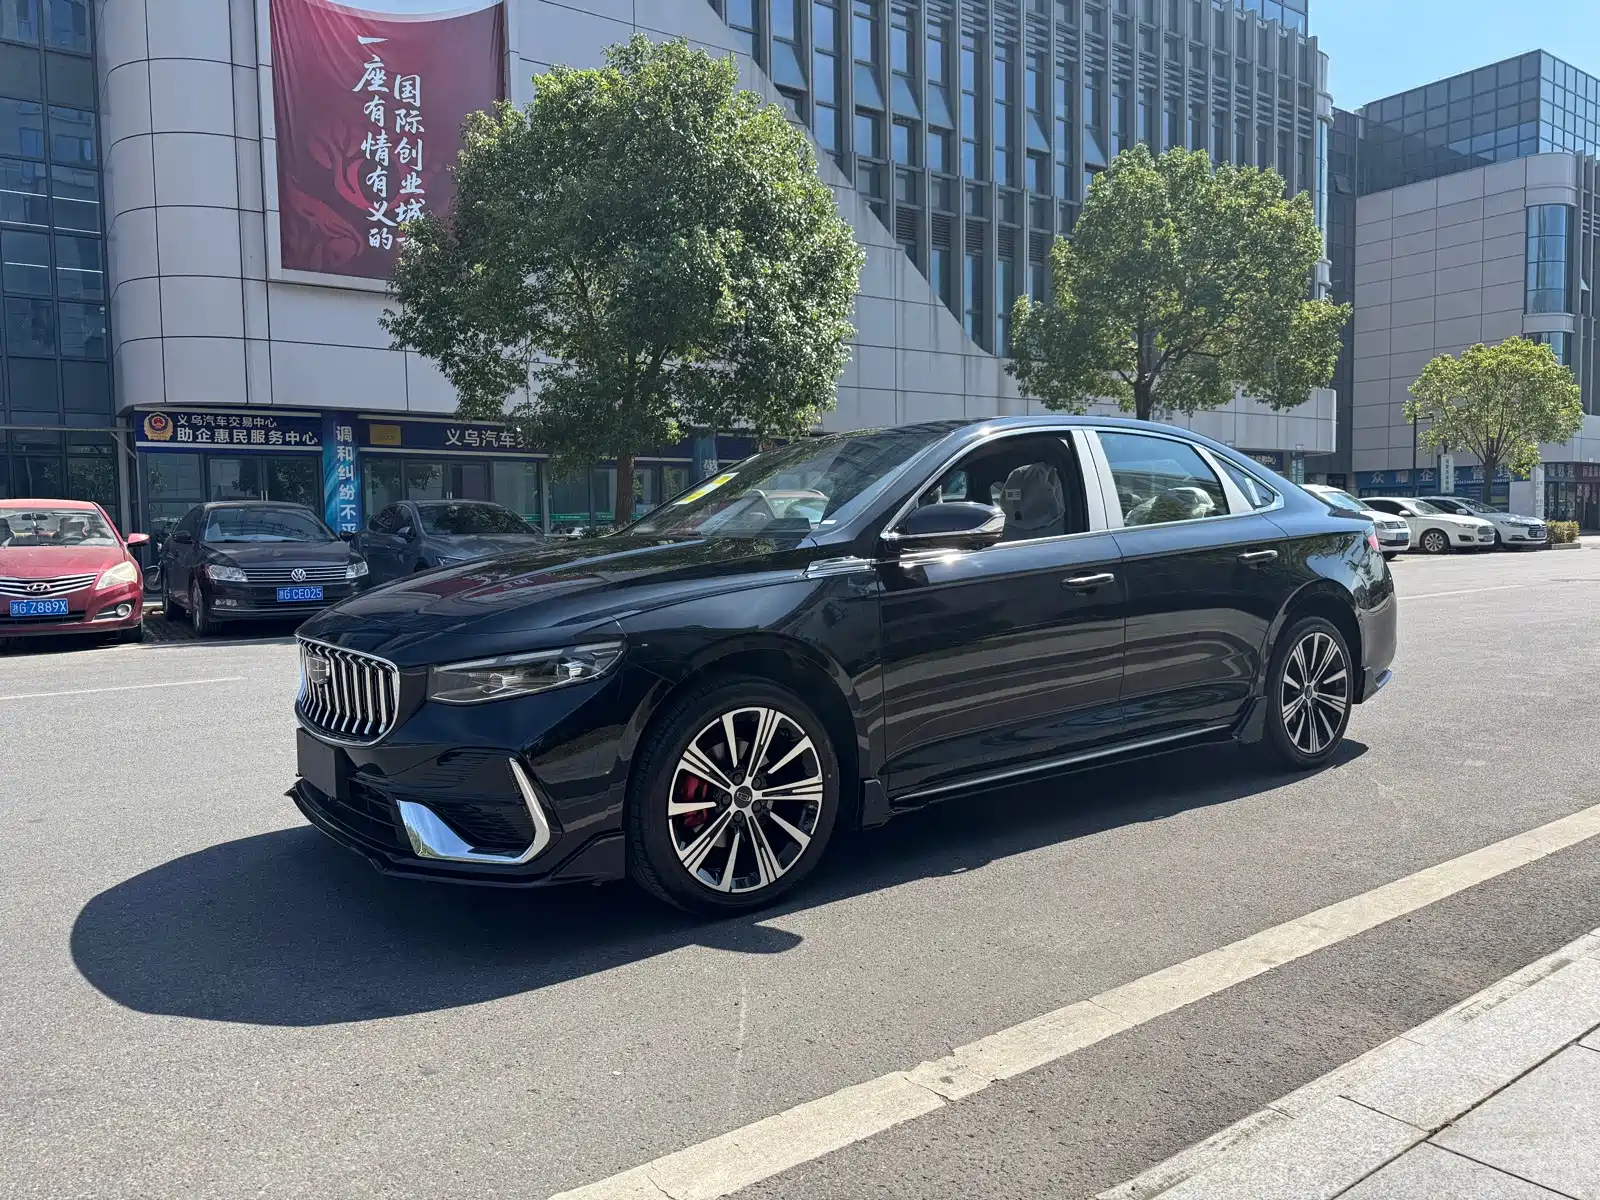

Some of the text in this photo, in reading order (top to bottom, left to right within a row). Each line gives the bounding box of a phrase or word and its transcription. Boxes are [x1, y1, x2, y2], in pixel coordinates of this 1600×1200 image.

[352, 34, 398, 250] 一座有情有义的
[393, 73, 426, 241] 国际创业城
[176, 414, 277, 428] 义乌汽车交易中心
[176, 427, 319, 445] 助企惠民服务中心
